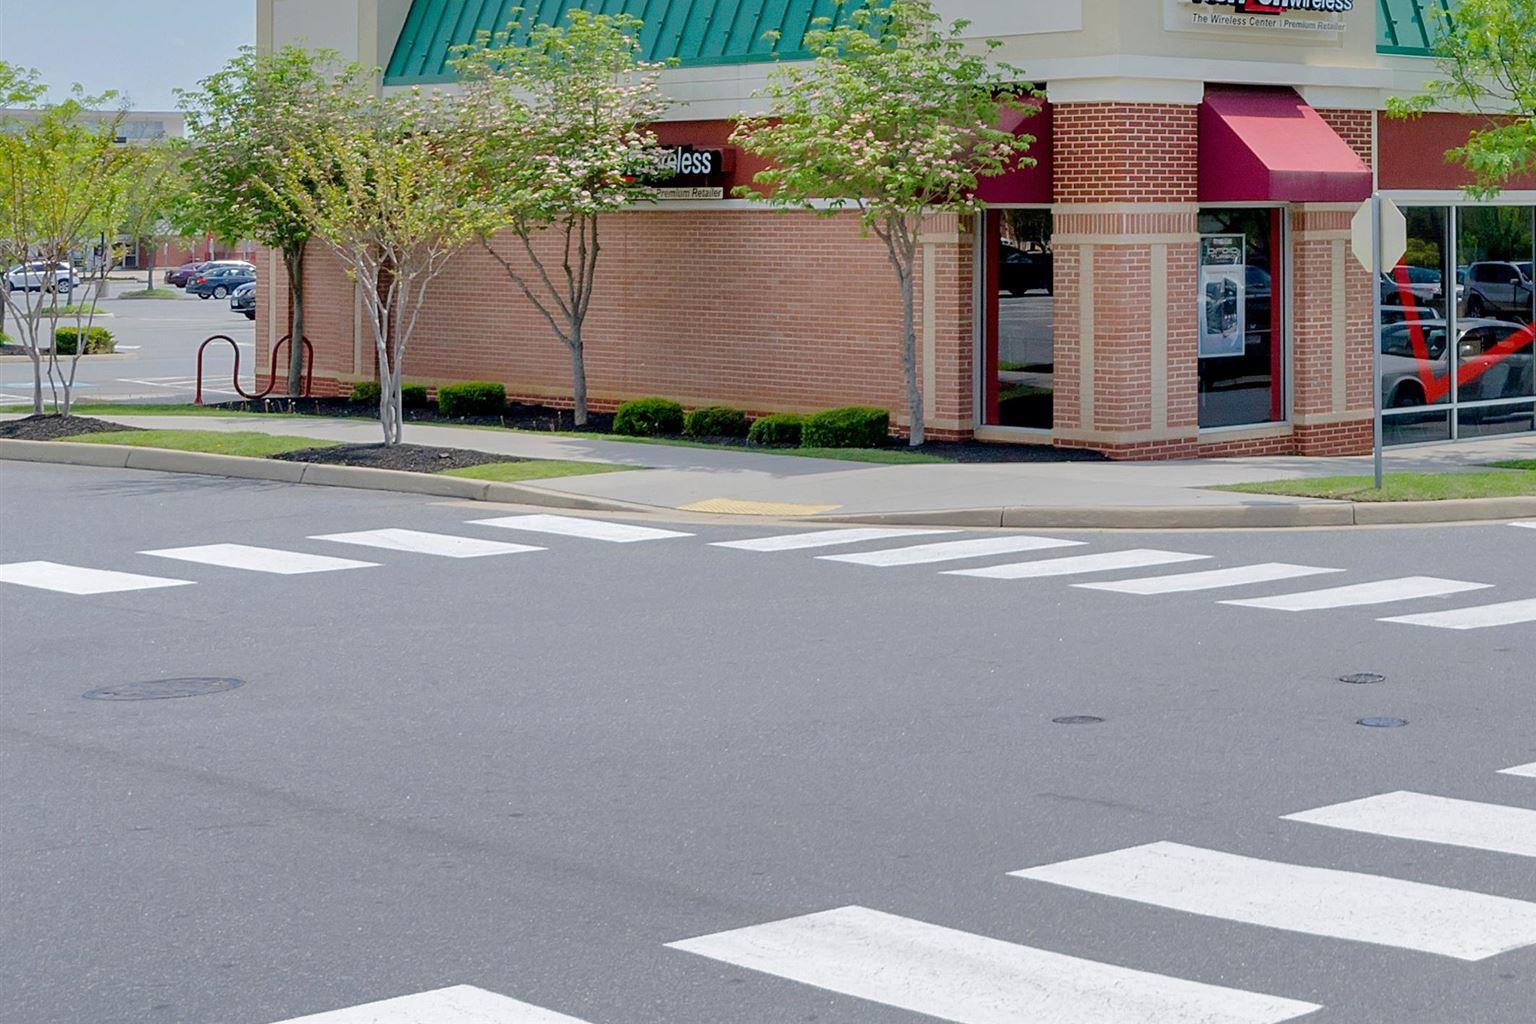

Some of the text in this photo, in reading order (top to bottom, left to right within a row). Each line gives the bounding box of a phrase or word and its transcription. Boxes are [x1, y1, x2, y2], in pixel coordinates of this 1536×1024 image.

[1193, 14, 1208, 24] The
[1211, 14, 1247, 26] Wireless
[1250, 17, 1276, 28] Center
[692, 187, 722, 198] Retailer
